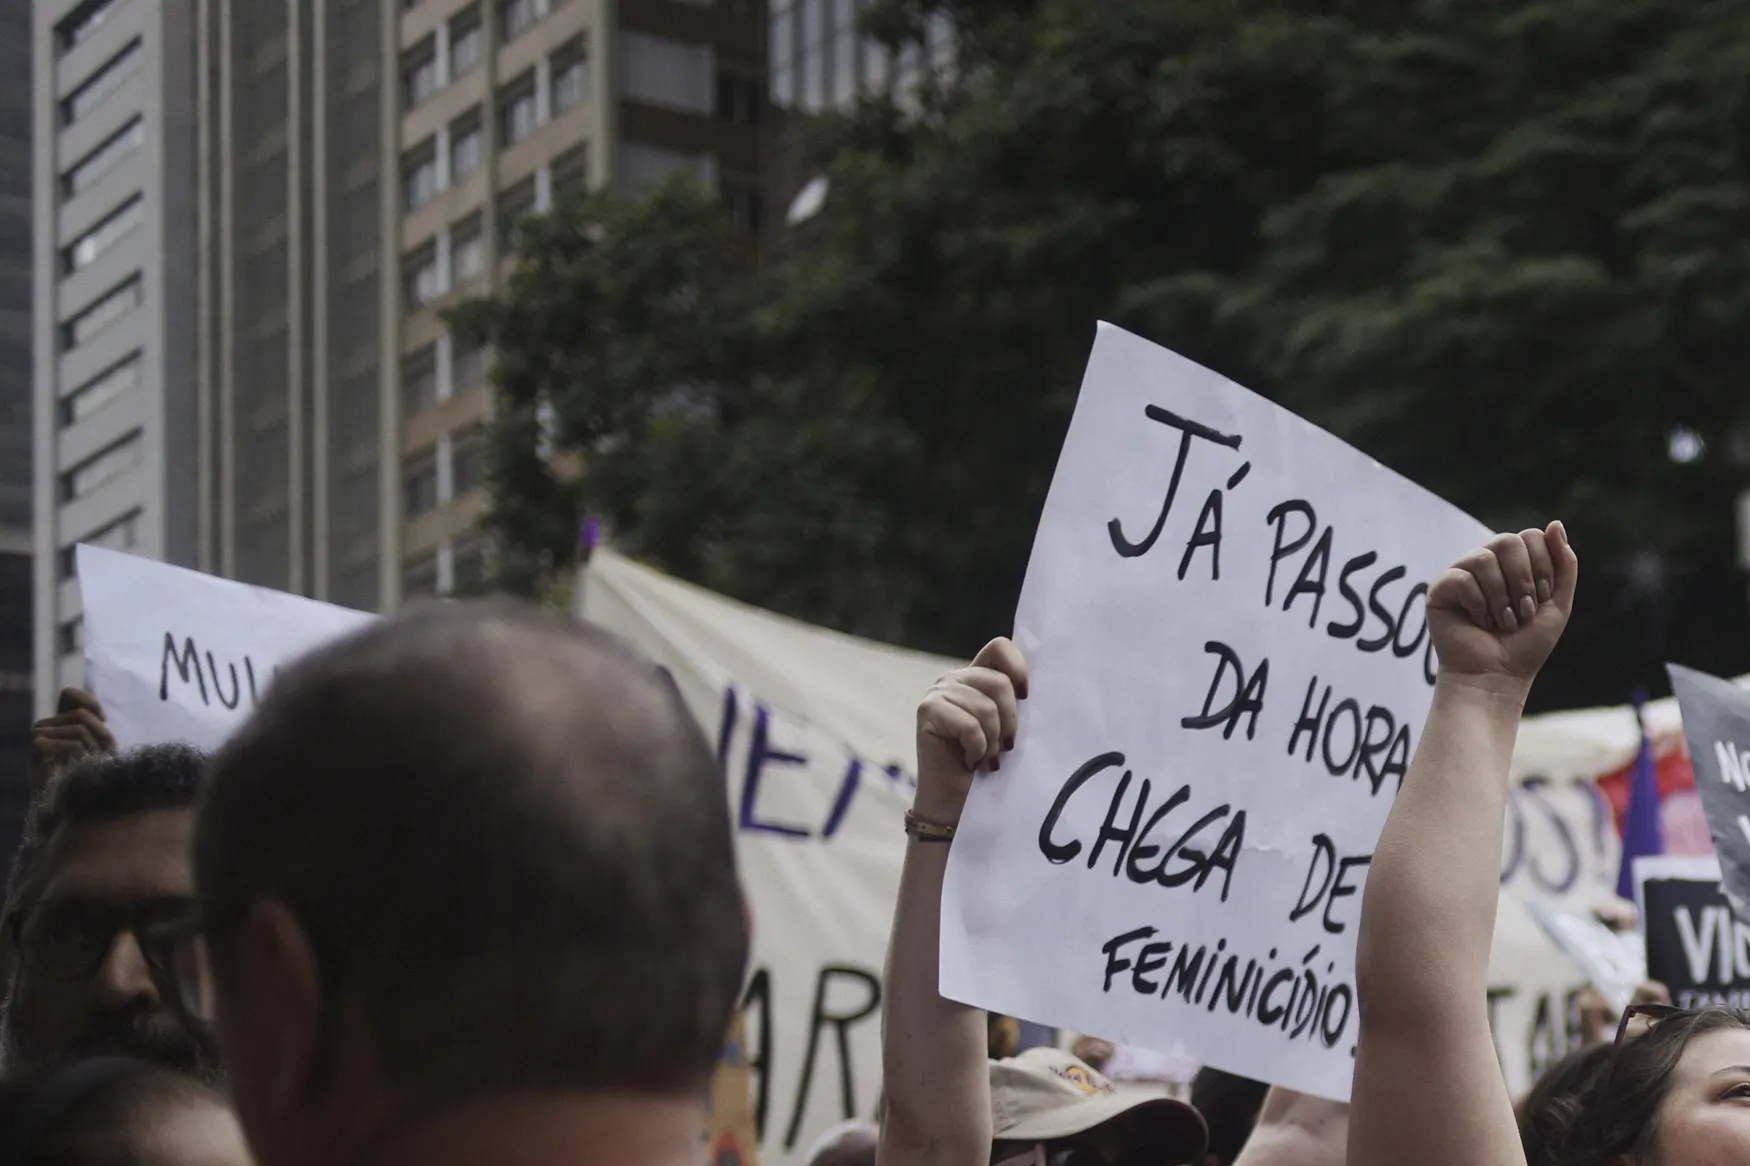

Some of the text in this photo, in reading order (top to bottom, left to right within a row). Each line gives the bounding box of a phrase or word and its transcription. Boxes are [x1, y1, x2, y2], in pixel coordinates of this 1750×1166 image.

[1107, 403, 1252, 581] JÁ
[1181, 641, 1411, 798] DA HORA
[1039, 751, 1247, 903] CHEGA
[1289, 833, 1372, 934] DE
